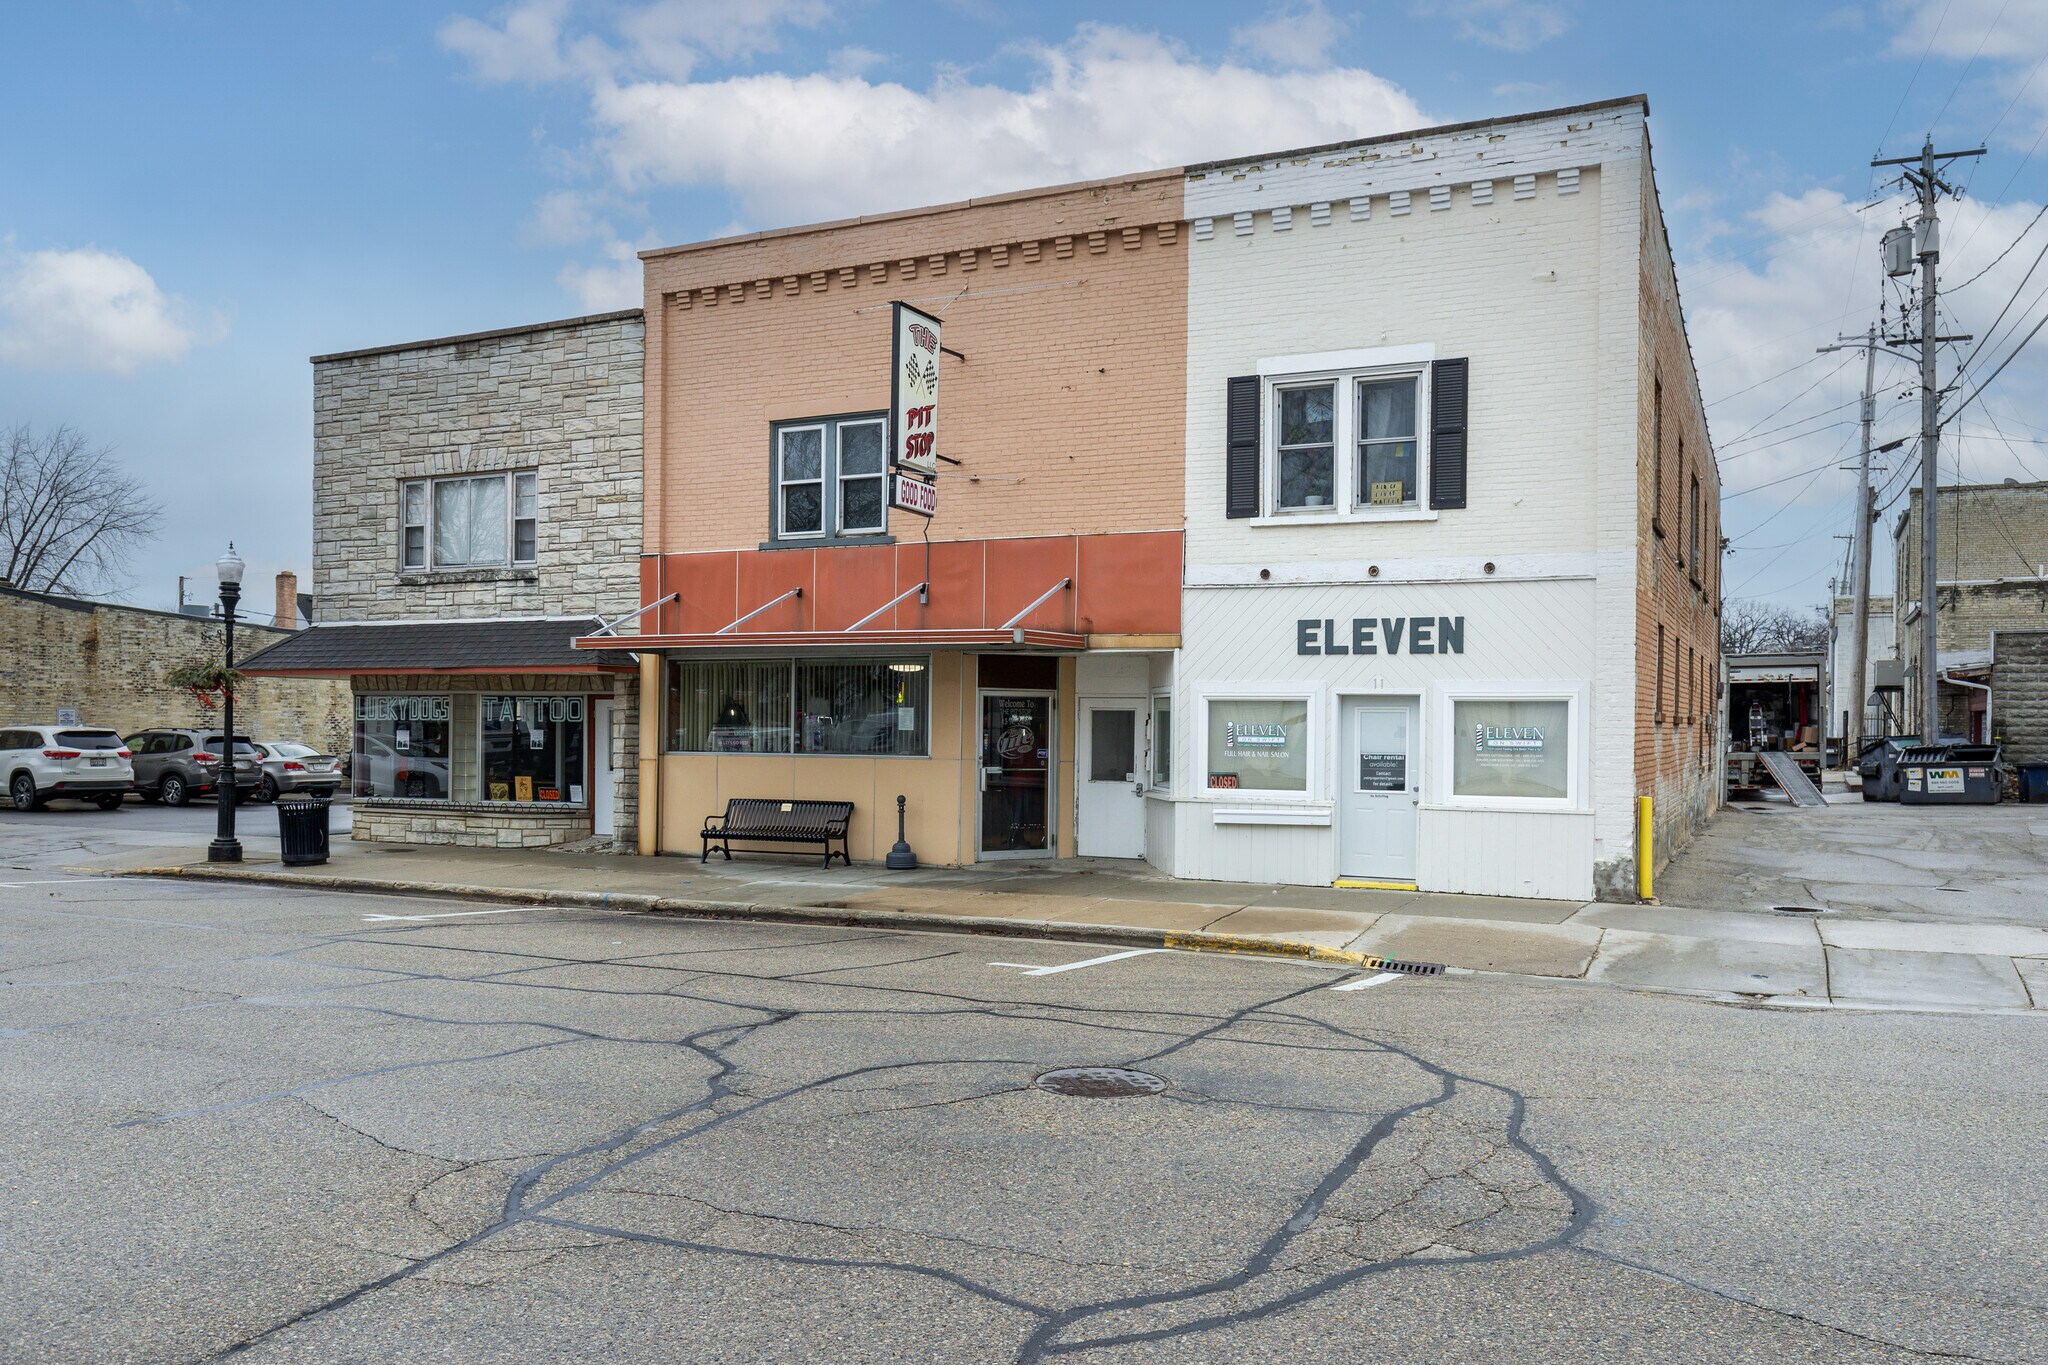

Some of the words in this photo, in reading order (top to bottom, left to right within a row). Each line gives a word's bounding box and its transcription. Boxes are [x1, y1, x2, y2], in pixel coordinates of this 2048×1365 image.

[909, 323, 938, 355] THE
[906, 404, 936, 431] PIT
[905, 431, 934, 460] STOP
[901, 479, 918, 506] GOOD
[919, 485, 936, 511] FOOD
[1297, 616, 1465, 656] ELEVEN
[1373, 678, 1384, 689] 11
[481, 696, 584, 723] TATTOO
[998, 699, 1026, 707] Welcome
[1026, 700, 1035, 708] To
[1236, 724, 1287, 737] ELEVEN
[1486, 726, 1544, 740] ELEVEN
[1928, 770, 1960, 779] WM
[1210, 775, 1237, 789] CLOSED
[539, 789, 560, 801] CLOSED
